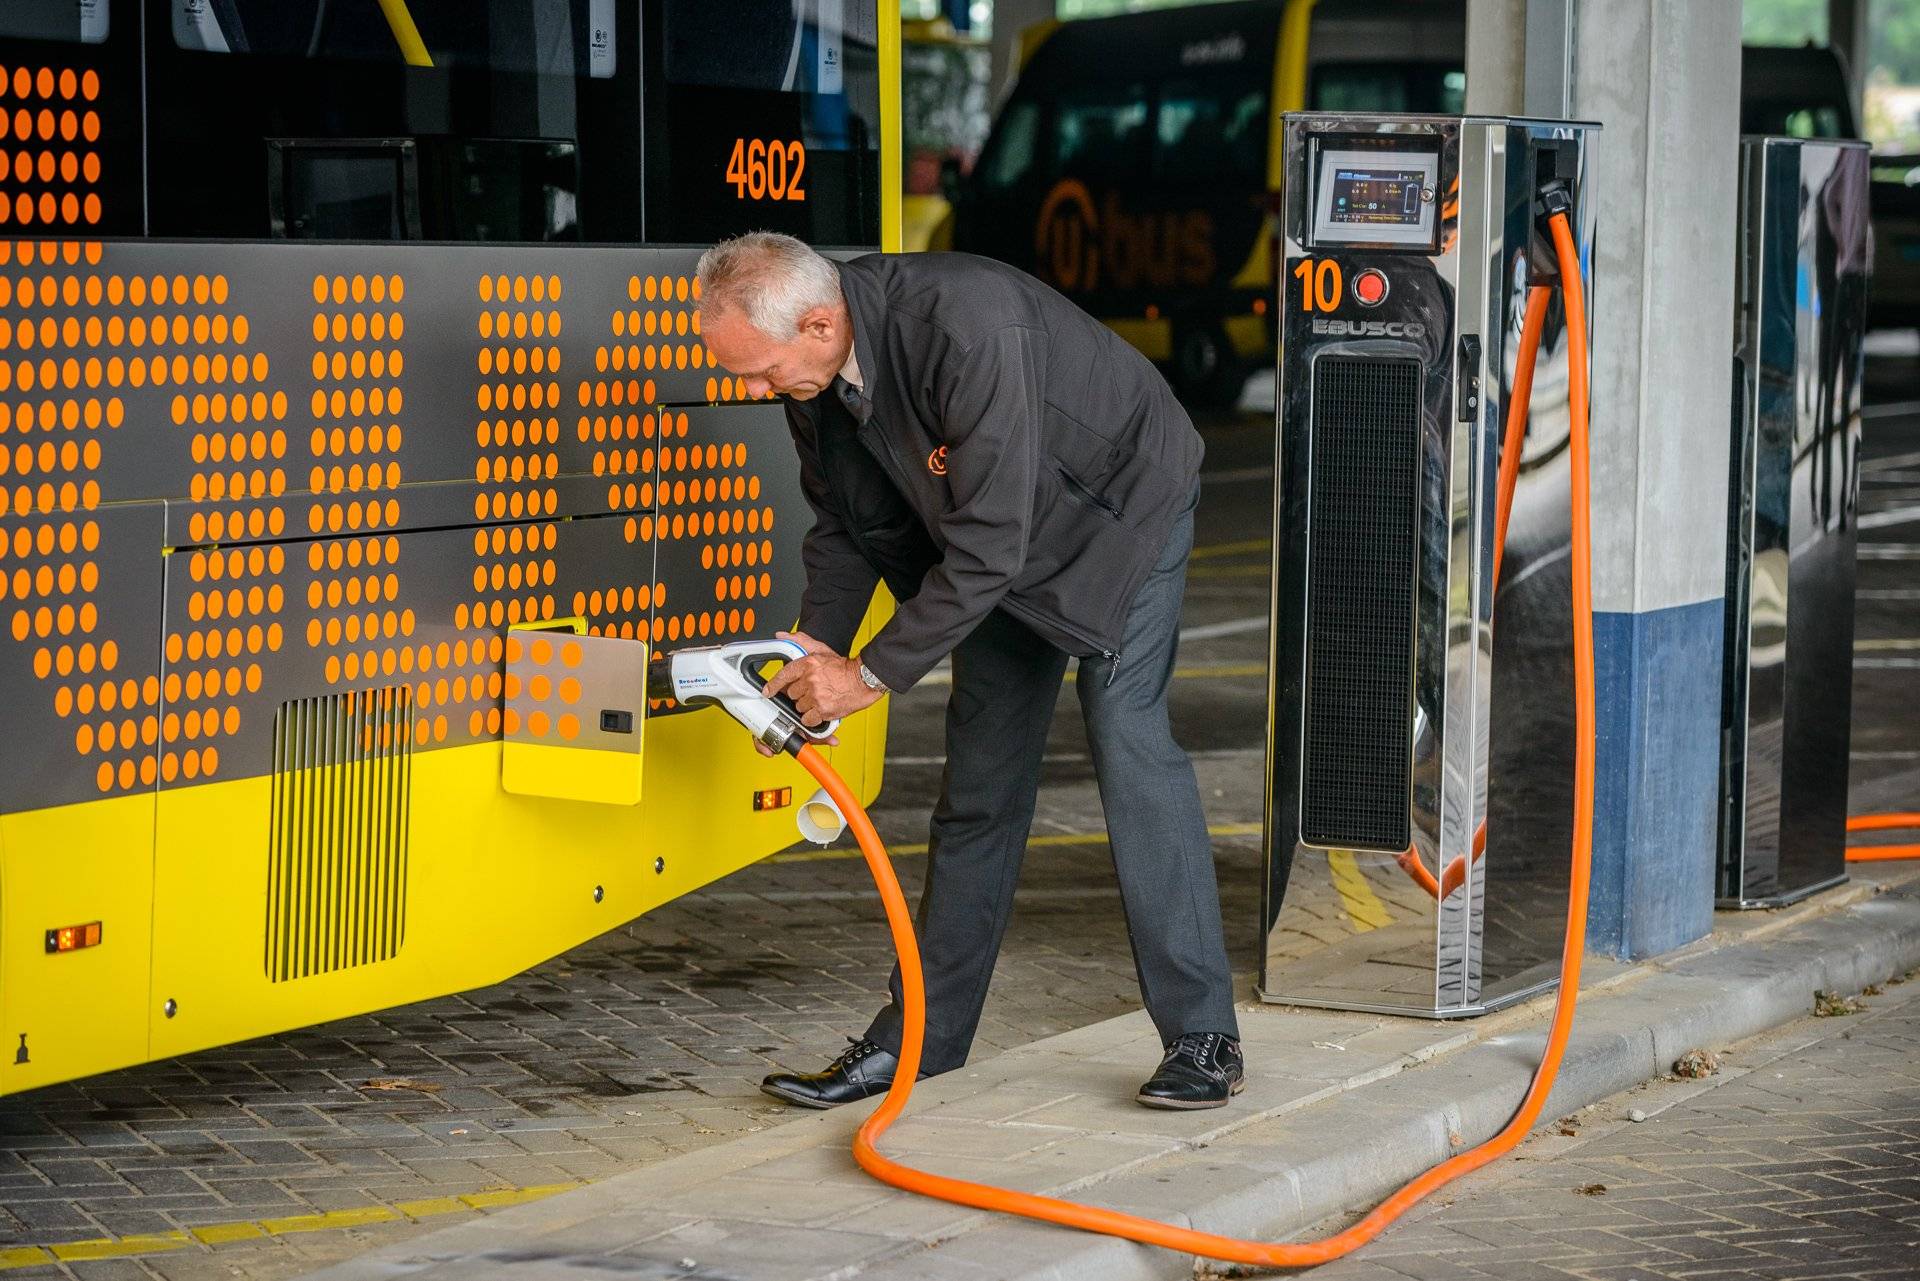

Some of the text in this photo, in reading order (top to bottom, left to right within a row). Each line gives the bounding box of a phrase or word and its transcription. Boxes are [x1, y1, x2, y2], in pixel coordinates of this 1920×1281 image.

[726, 138, 805, 201] 4602
[1294, 258, 1343, 313] 10
[1312, 318, 1426, 338] EBUSCO
